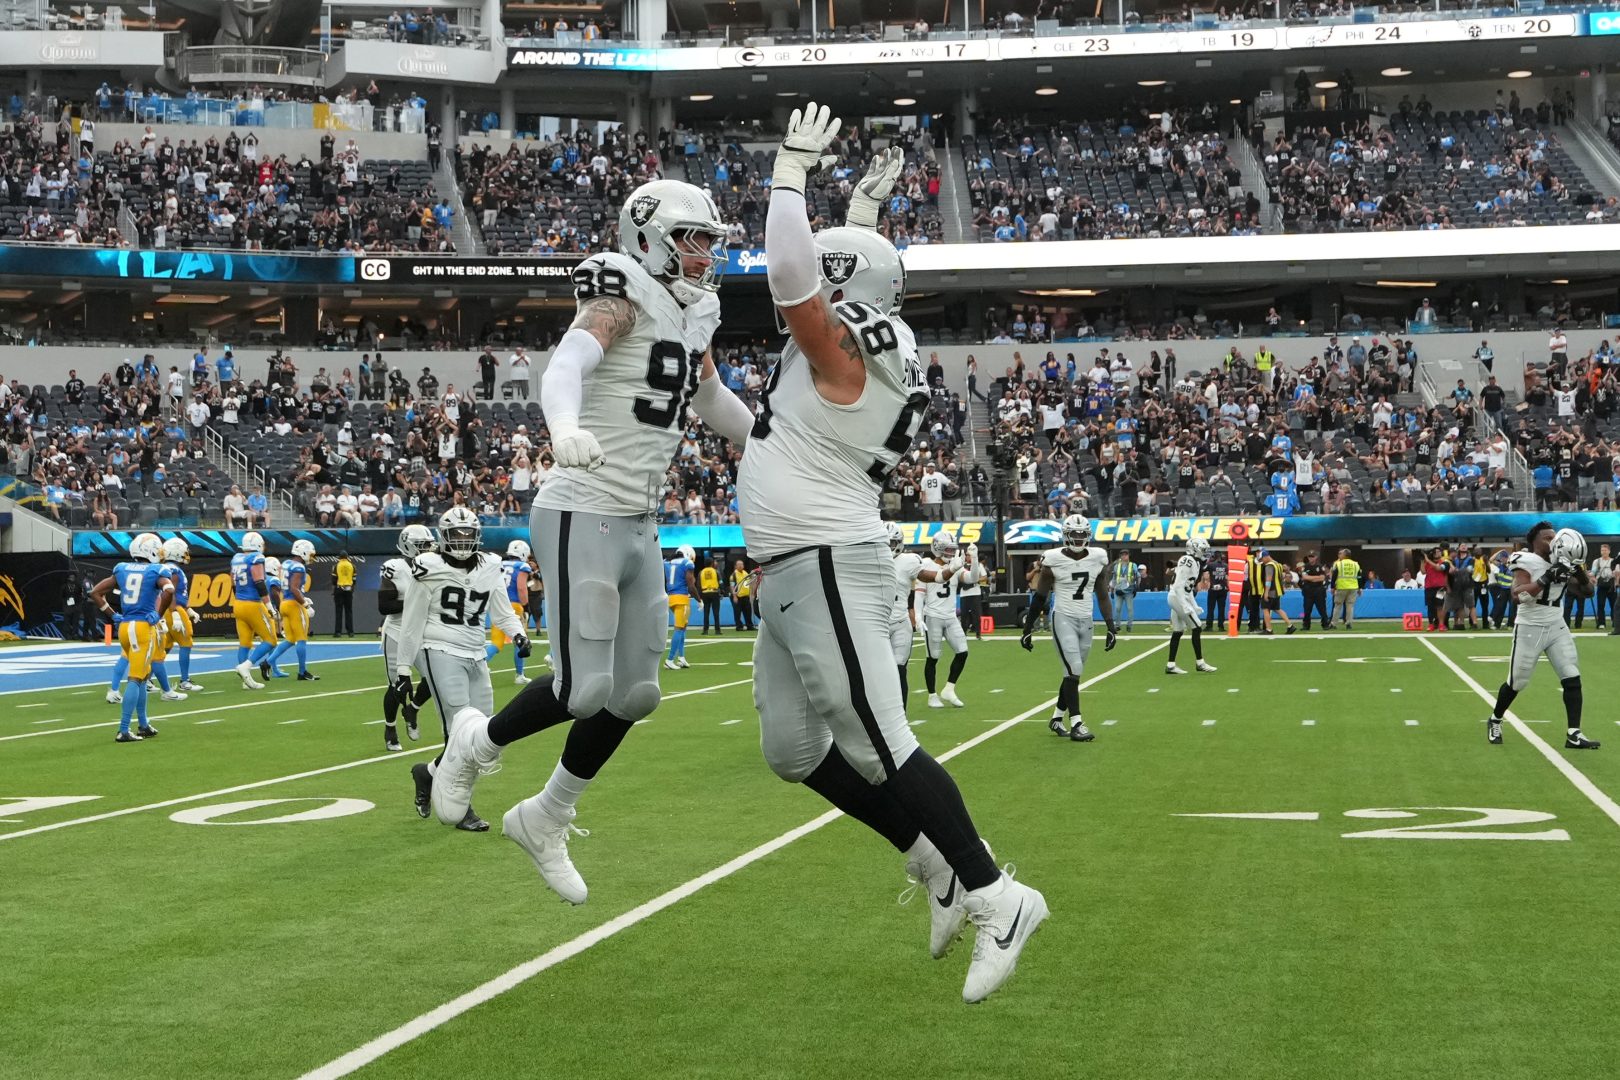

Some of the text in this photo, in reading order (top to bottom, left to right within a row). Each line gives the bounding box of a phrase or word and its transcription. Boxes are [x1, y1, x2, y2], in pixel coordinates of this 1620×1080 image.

[1494, 20, 1551, 33] TEN 20
[1201, 33, 1254, 46] TB 19
[1345, 27, 1401, 40] PHI 24
[911, 44, 966, 57] NYJ 17
[1084, 39, 1110, 52] 23
[512, 52, 580, 65] AROUND
[583, 53, 615, 65] THE
[775, 48, 827, 62] GB 20
[1082, 209, 1092, 217] 75
[738, 251, 767, 272] Spli
[364, 263, 387, 277] CC
[412, 266, 573, 276] GHT IN THE END ZONE. THE RESULT
[70, 382, 80, 391] 75
[1180, 385, 1192, 393] 98
[284, 398, 296, 407] 34
[446, 399, 457, 407] 89
[1210, 443, 1219, 453] 21
[1231, 443, 1242, 452] 24
[1418, 444, 1430, 455] 98
[978, 473, 984, 482] 2
[1181, 467, 1192, 476] 89
[1560, 468, 1571, 478] 13
[717, 476, 728, 486] 34
[927, 479, 938, 489] 89
[904, 486, 914, 496] 16
[410, 497, 420, 507] 60
[1278, 498, 1288, 509] 81
[1094, 518, 1284, 542] CHARGERS
[123, 573, 143, 604] 9
[188, 573, 235, 608] BO
[937, 581, 951, 598] 3
[1072, 572, 1089, 600] 7
[441, 586, 490, 626] 97
[1405, 615, 1420, 629] 20
[1341, 806, 1571, 841] 2
